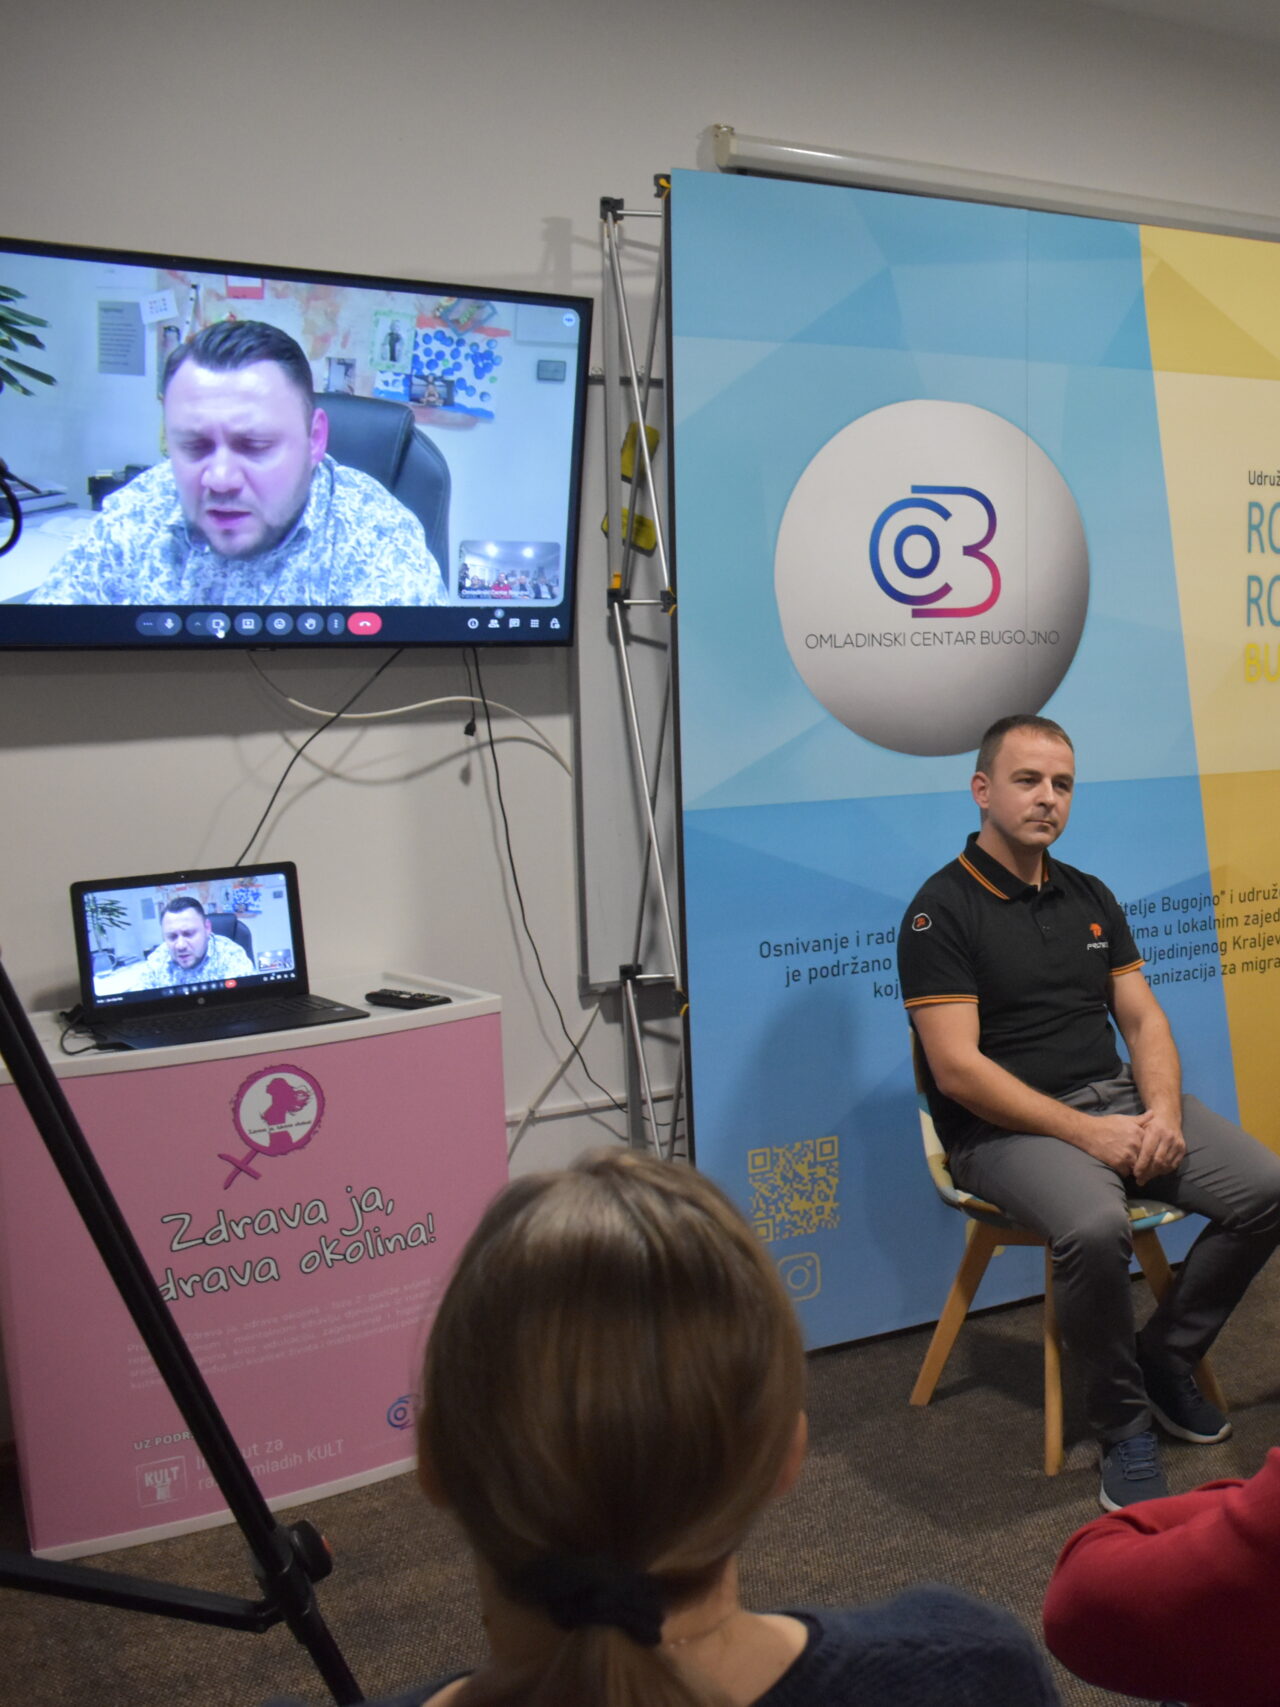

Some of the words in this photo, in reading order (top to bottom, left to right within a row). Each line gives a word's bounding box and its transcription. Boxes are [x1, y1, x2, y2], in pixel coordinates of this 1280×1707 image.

[804, 632, 906, 649] OMLADINSKI
[910, 631, 976, 647] CENTAR
[980, 629, 1060, 645] BUGOJNO
[759, 932, 849, 958] Osnivanje
[855, 930, 860, 948] i
[866, 926, 896, 946] rad
[1229, 889, 1234, 904] i
[785, 966, 802, 988] je
[808, 956, 892, 985] podržano
[1131, 924, 1159, 940] ima
[1164, 924, 1172, 936] u
[1177, 915, 1239, 935] lokalnim
[873, 978, 899, 1000] koj
[1141, 940, 1228, 966] Ujedinjenog
[1221, 961, 1236, 976] za
[161, 1199, 328, 1252] Zdrava
[340, 1185, 394, 1236] ja,
[158, 1256, 280, 1301] drava
[299, 1213, 437, 1274] okolina!
[134, 1440, 152, 1451] UZ
[155, 1431, 195, 1446] PODR
[251, 1453, 303, 1477] mladih
[306, 1439, 345, 1463] KULT
[264, 1439, 284, 1454] za
[144, 1466, 180, 1488] KULT
